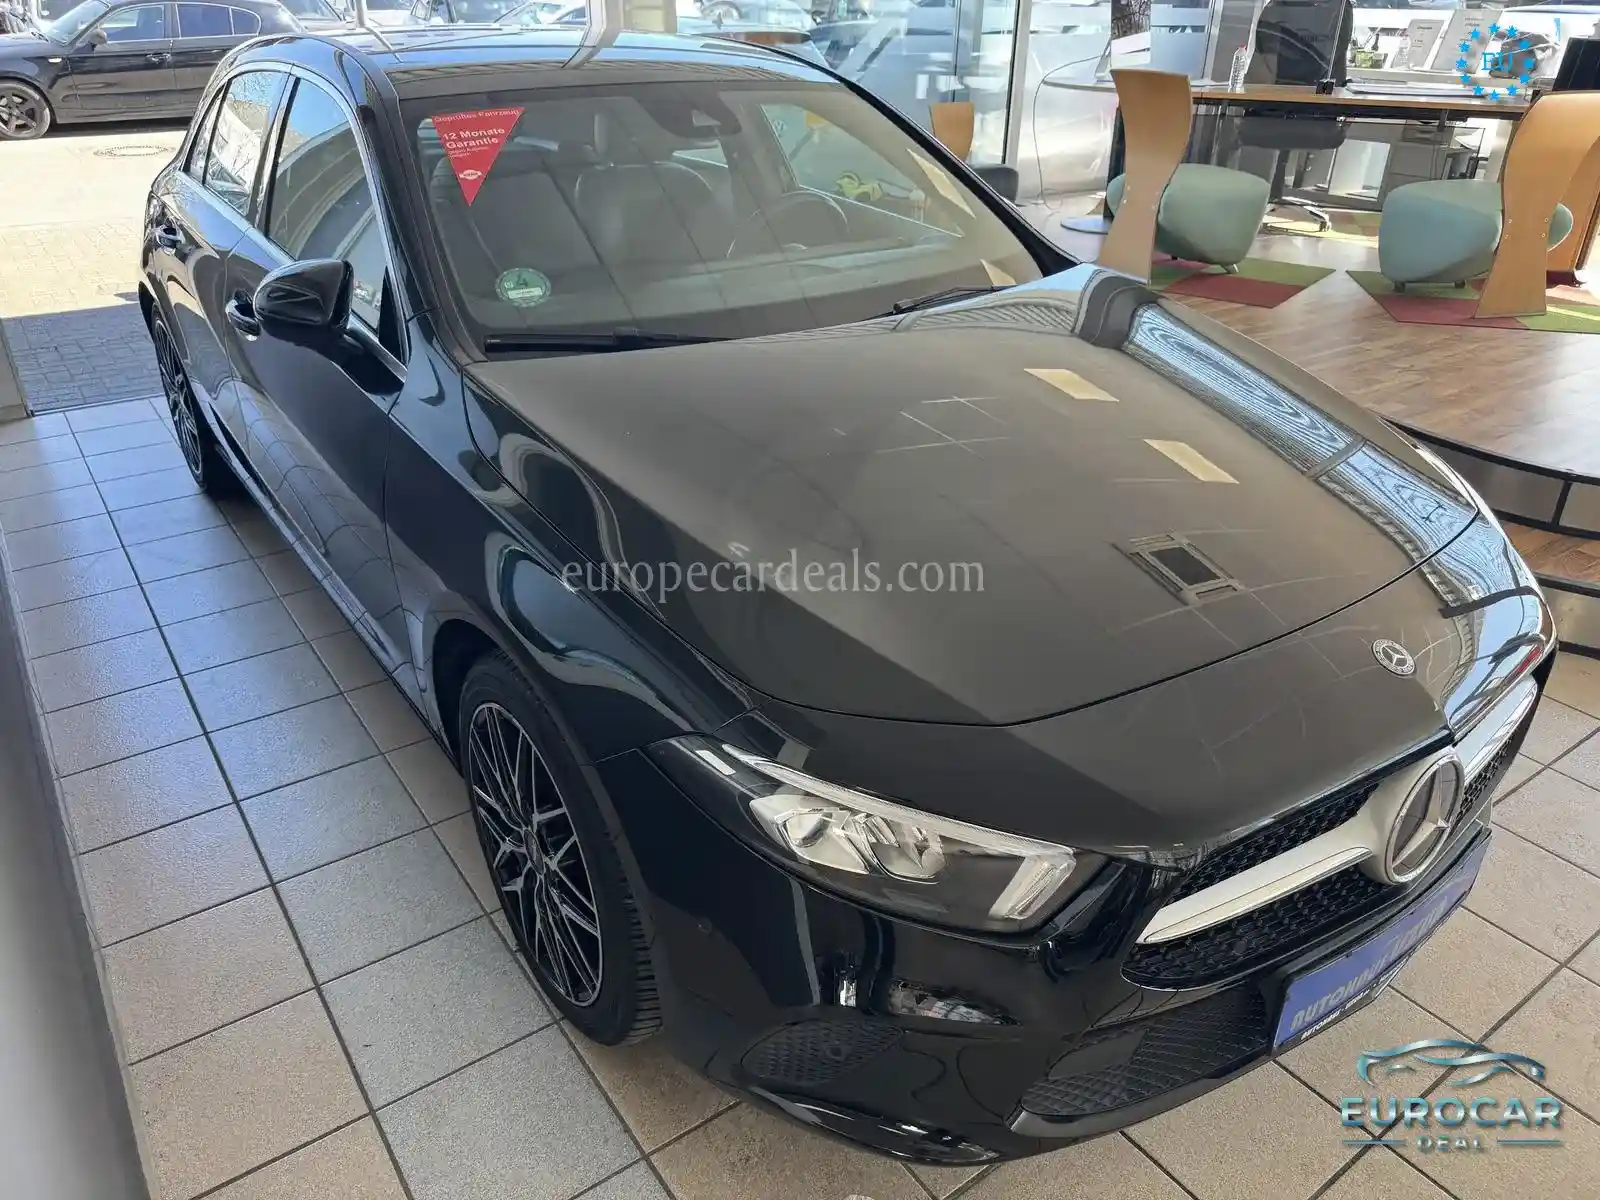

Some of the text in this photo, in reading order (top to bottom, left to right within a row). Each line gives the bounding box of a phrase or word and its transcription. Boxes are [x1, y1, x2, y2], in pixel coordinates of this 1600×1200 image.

[443, 128, 505, 140] 12 Monate
[446, 137, 498, 149] Garantie
